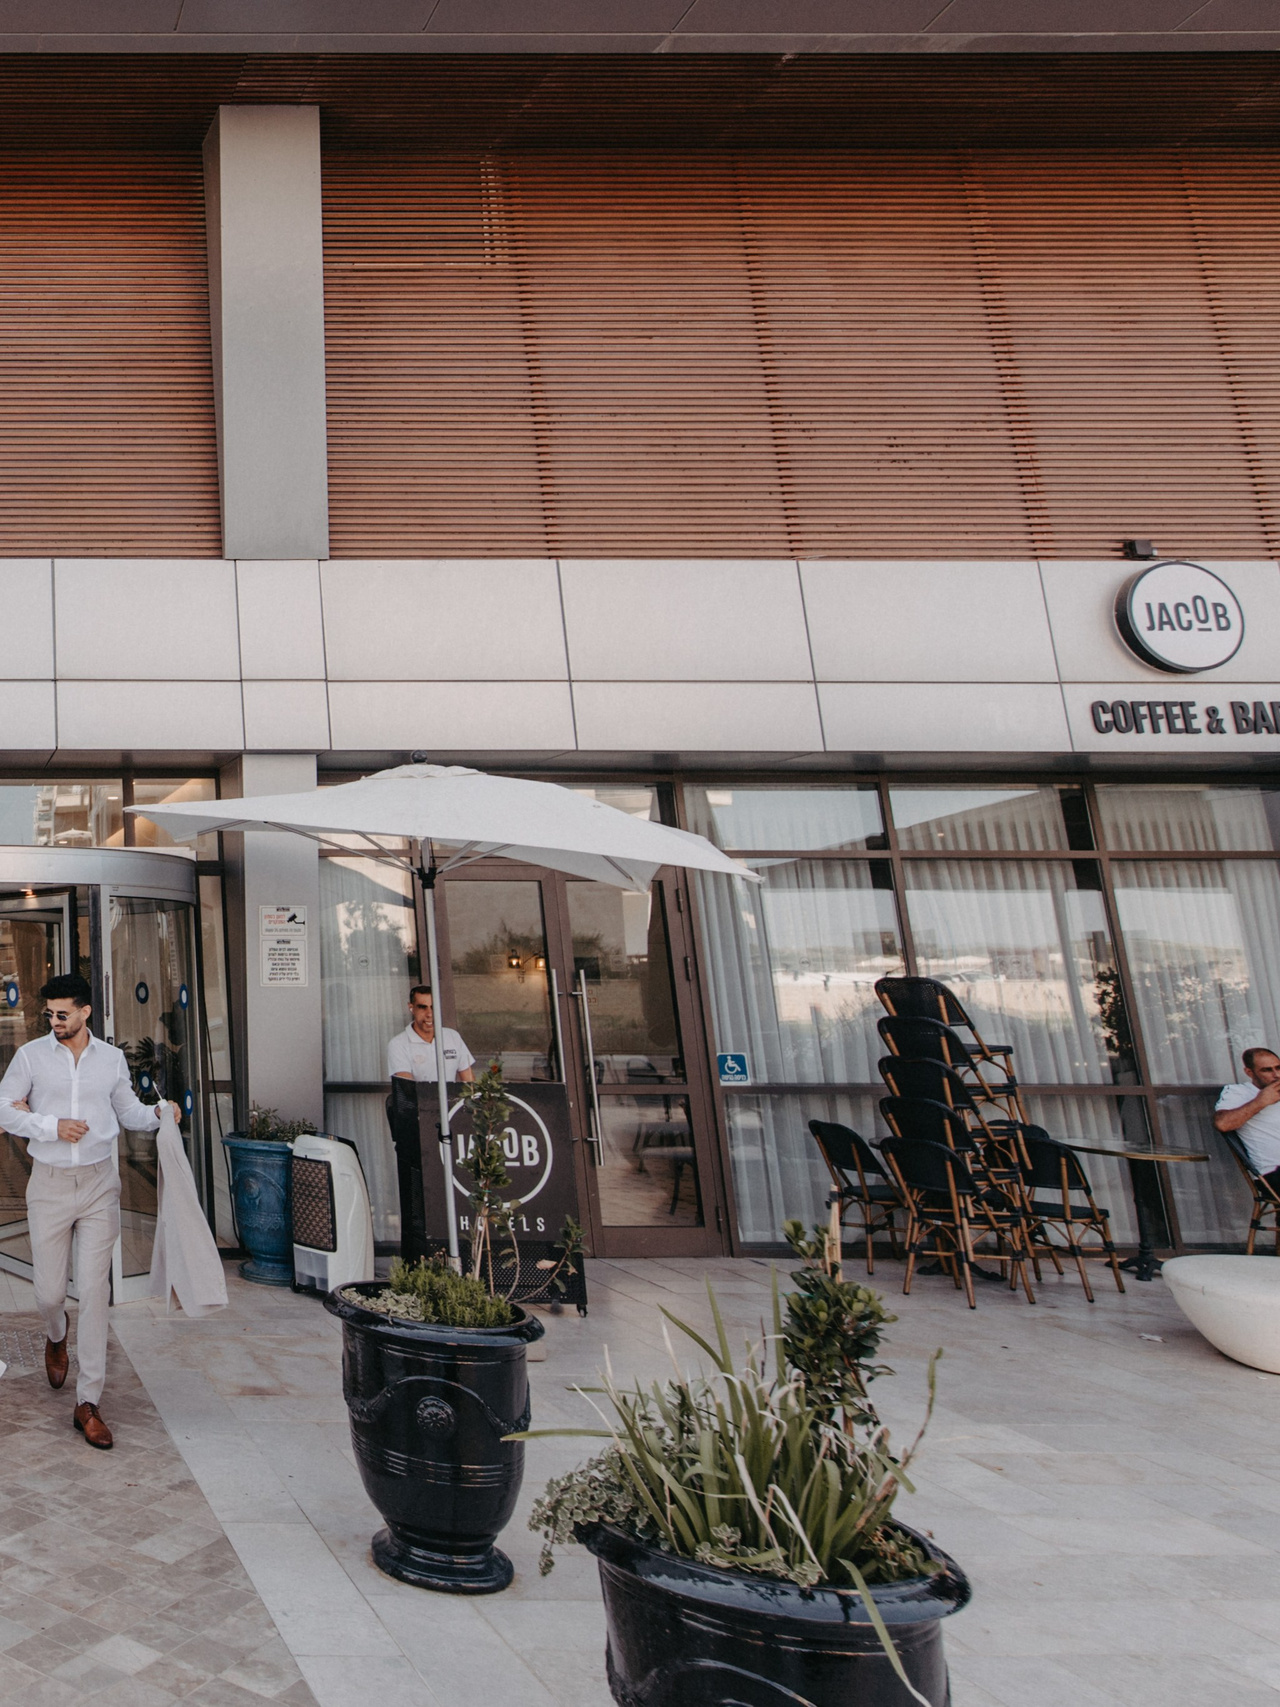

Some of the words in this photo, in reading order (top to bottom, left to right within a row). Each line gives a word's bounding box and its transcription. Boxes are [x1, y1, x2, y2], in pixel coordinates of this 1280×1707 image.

[1145, 595, 1231, 631] JACOB
[1091, 700, 1201, 734] COFFEE
[1206, 705, 1227, 734] &
[456, 1127, 539, 1166] JOB
[460, 1216, 545, 1231] HOELS
